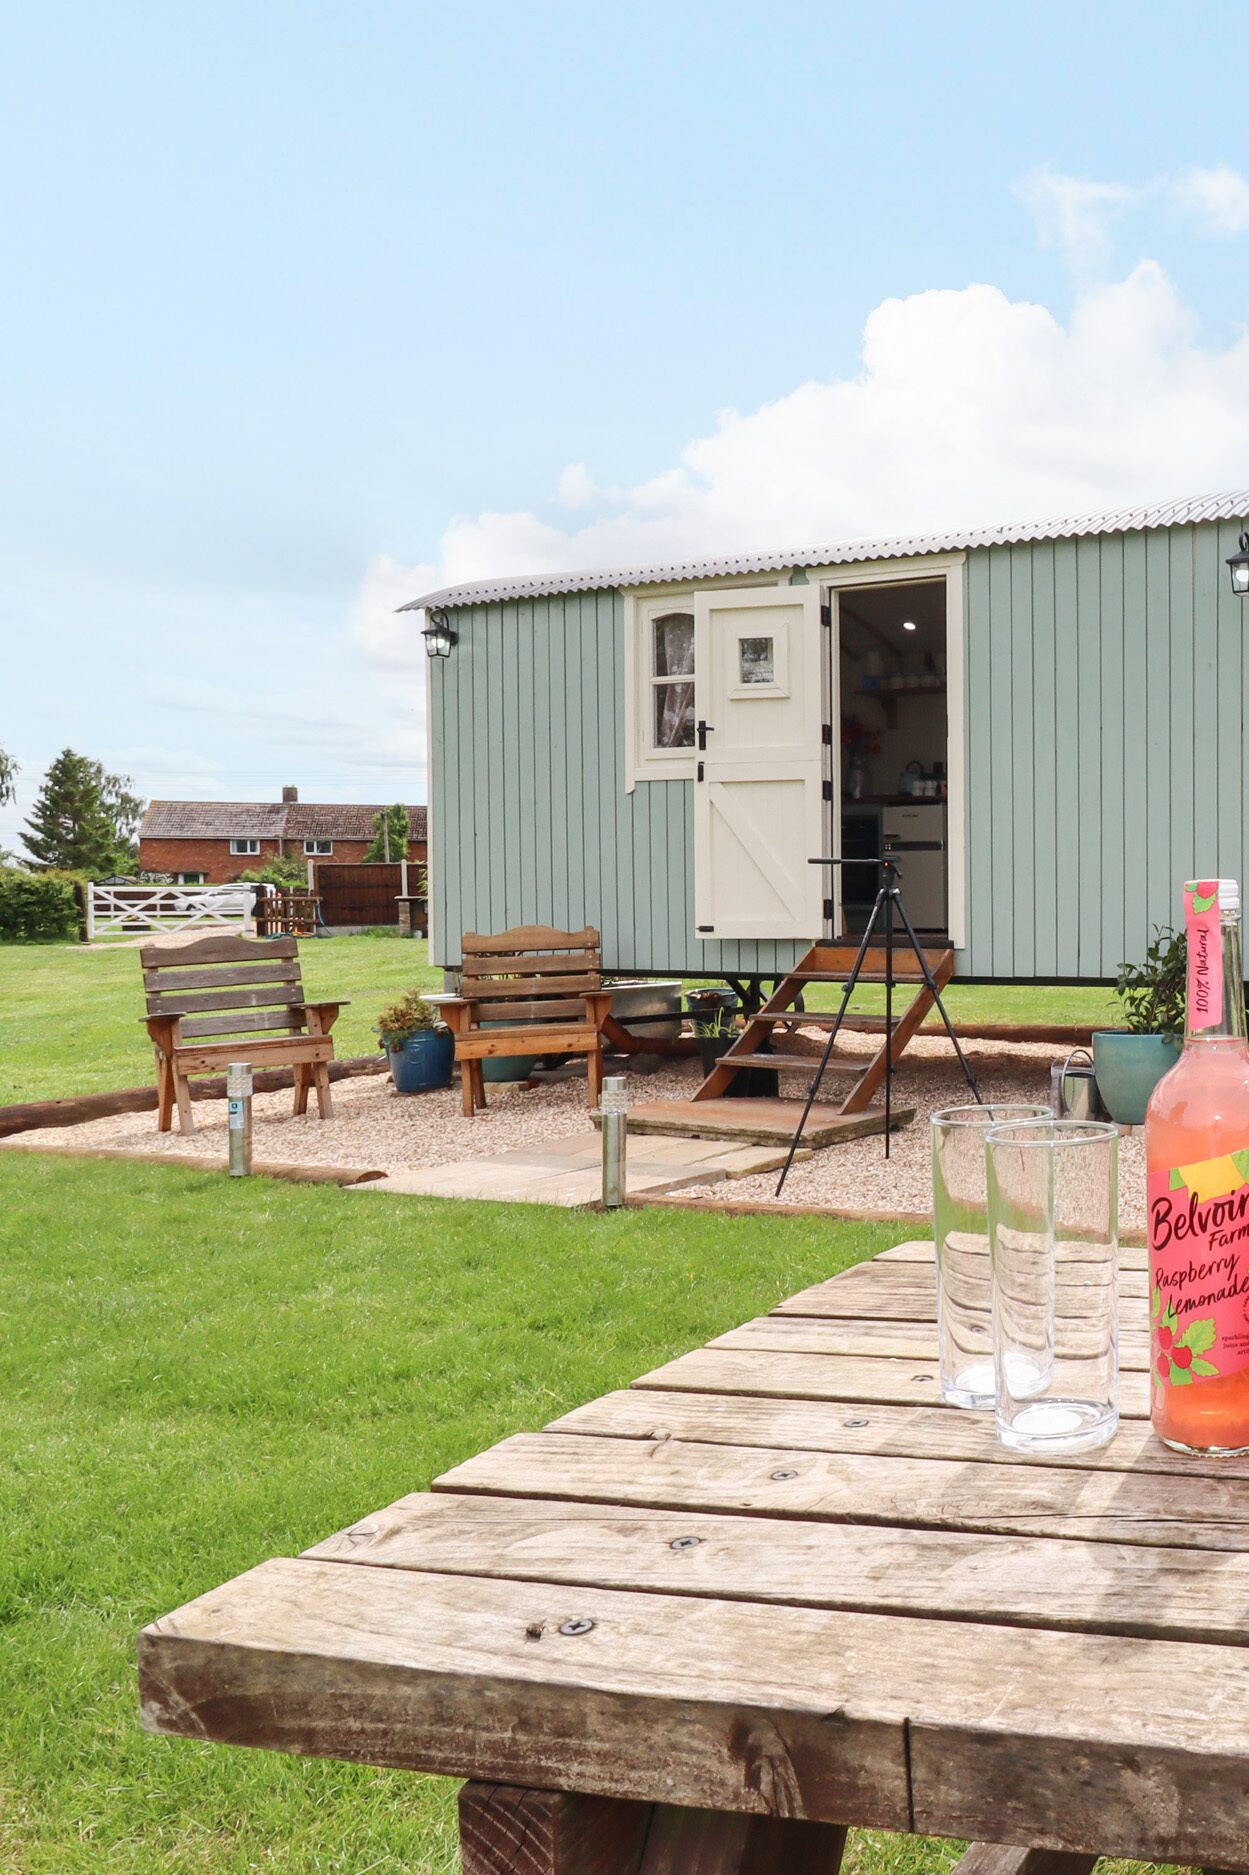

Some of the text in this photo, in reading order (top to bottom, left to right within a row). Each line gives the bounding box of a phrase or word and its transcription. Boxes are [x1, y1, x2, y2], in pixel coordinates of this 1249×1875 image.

[1195, 928, 1210, 1013] 100% Natural
[1155, 1253, 1240, 1291] Raspberry
